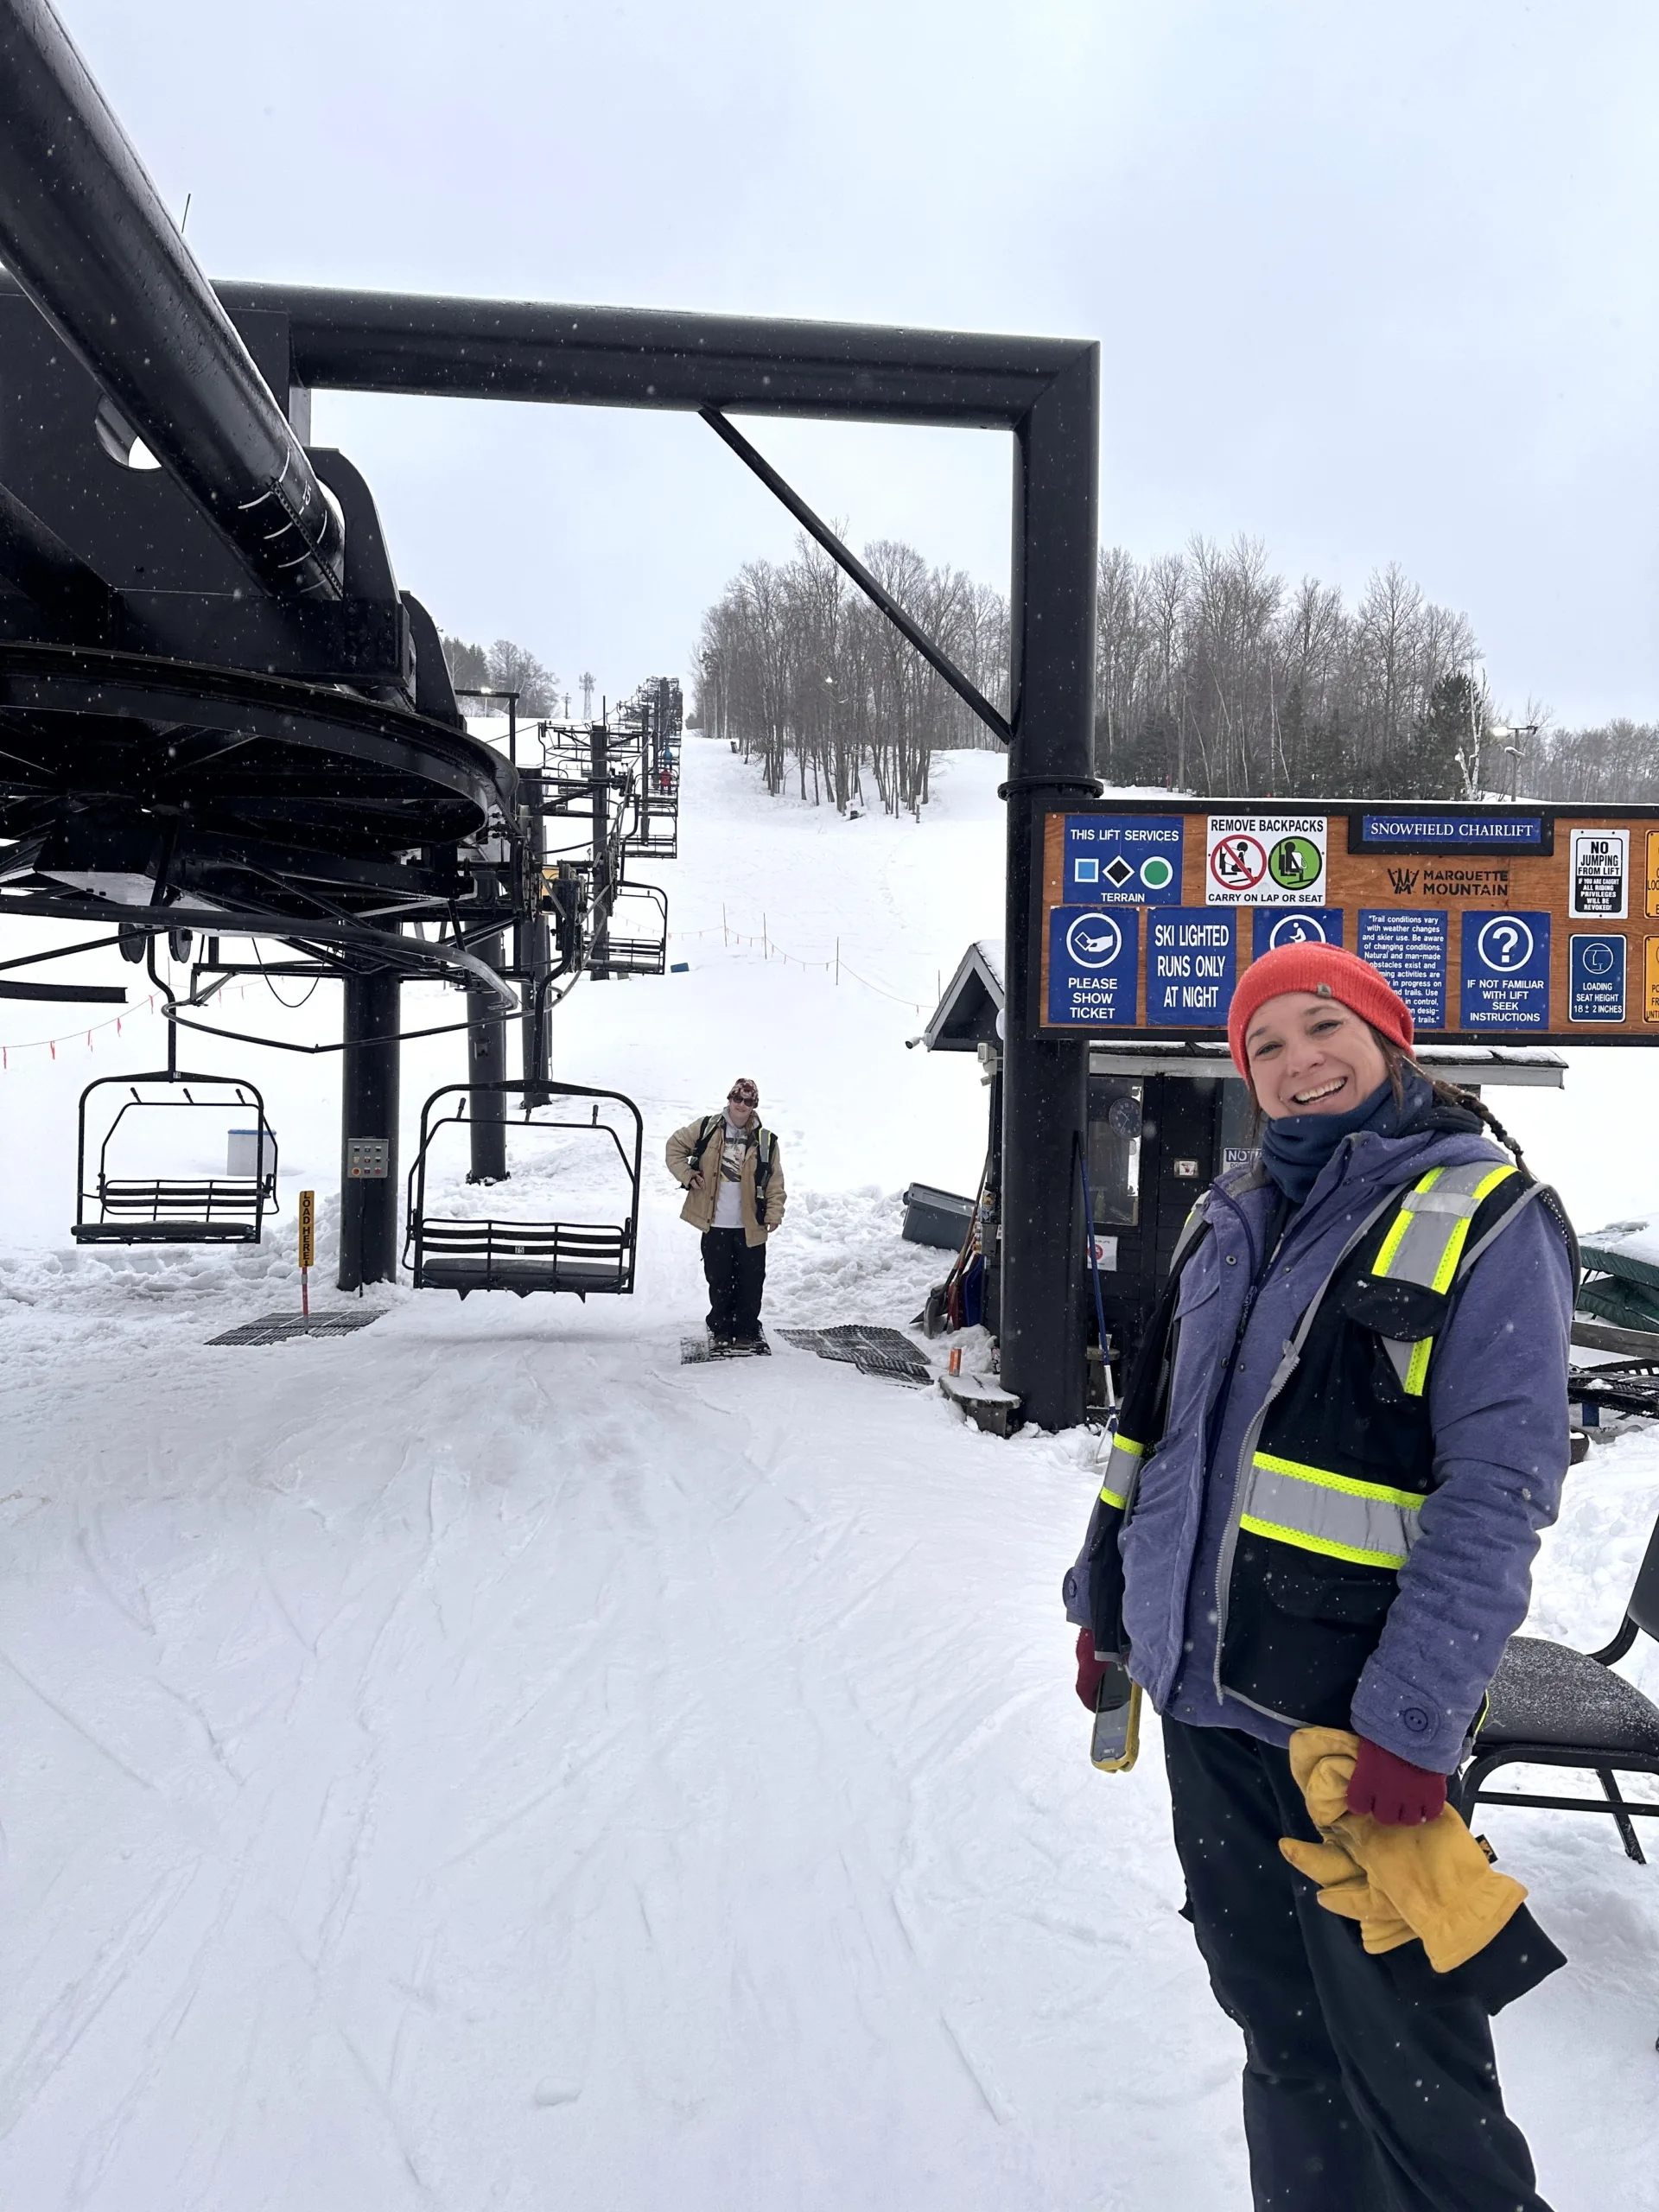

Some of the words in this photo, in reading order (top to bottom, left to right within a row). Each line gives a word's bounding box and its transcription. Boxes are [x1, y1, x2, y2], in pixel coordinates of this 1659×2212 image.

[1211, 819, 1256, 831] REMOVE
[1259, 820, 1323, 832] BACKPACKS
[1371, 823, 1454, 836] SNOWFIELD
[1459, 824, 1533, 836] CHAIRLIFT
[1071, 829, 1095, 840] THIS
[1099, 830, 1120, 840] LIFT
[1124, 830, 1179, 841] SERVICES
[1591, 841, 1609, 854] NO
[1581, 855, 1618, 866] JUMPING
[1423, 870, 1508, 881] MARQUETTE
[1423, 884, 1508, 896] MOUNTAIN
[1101, 893, 1145, 902] TERRAIN
[1155, 925, 1175, 946] SKI
[1179, 925, 1229, 947] LIGHTED
[1374, 943, 1403, 951] changing
[1157, 956, 1191, 977] RUNS
[1196, 956, 1226, 977] ONLY
[1068, 978, 1117, 989] PLEASE
[1467, 980, 1476, 988] IF
[1479, 980, 1499, 988] NOT
[1502, 980, 1544, 989] FAMILIAR
[1583, 982, 1613, 991] LOADING
[1072, 993, 1113, 1004] SHOW
[1164, 986, 1179, 1007] AT
[1183, 986, 1219, 1008] NIGHT
[1483, 991, 1506, 999] WITH
[1510, 991, 1529, 999] LIFT
[1576, 994, 1593, 1002] SEAT
[1595, 994, 1619, 1002] HEIGHT
[1492, 1002, 1519, 1010] SEEK
[1574, 1005, 1583, 1013] 18
[1069, 1007, 1115, 1019] TICKET
[1470, 1013, 1540, 1022] INSTRUCTIONS
[302, 1191, 310, 1225] LOAD
[302, 1227, 310, 1260] HERE
